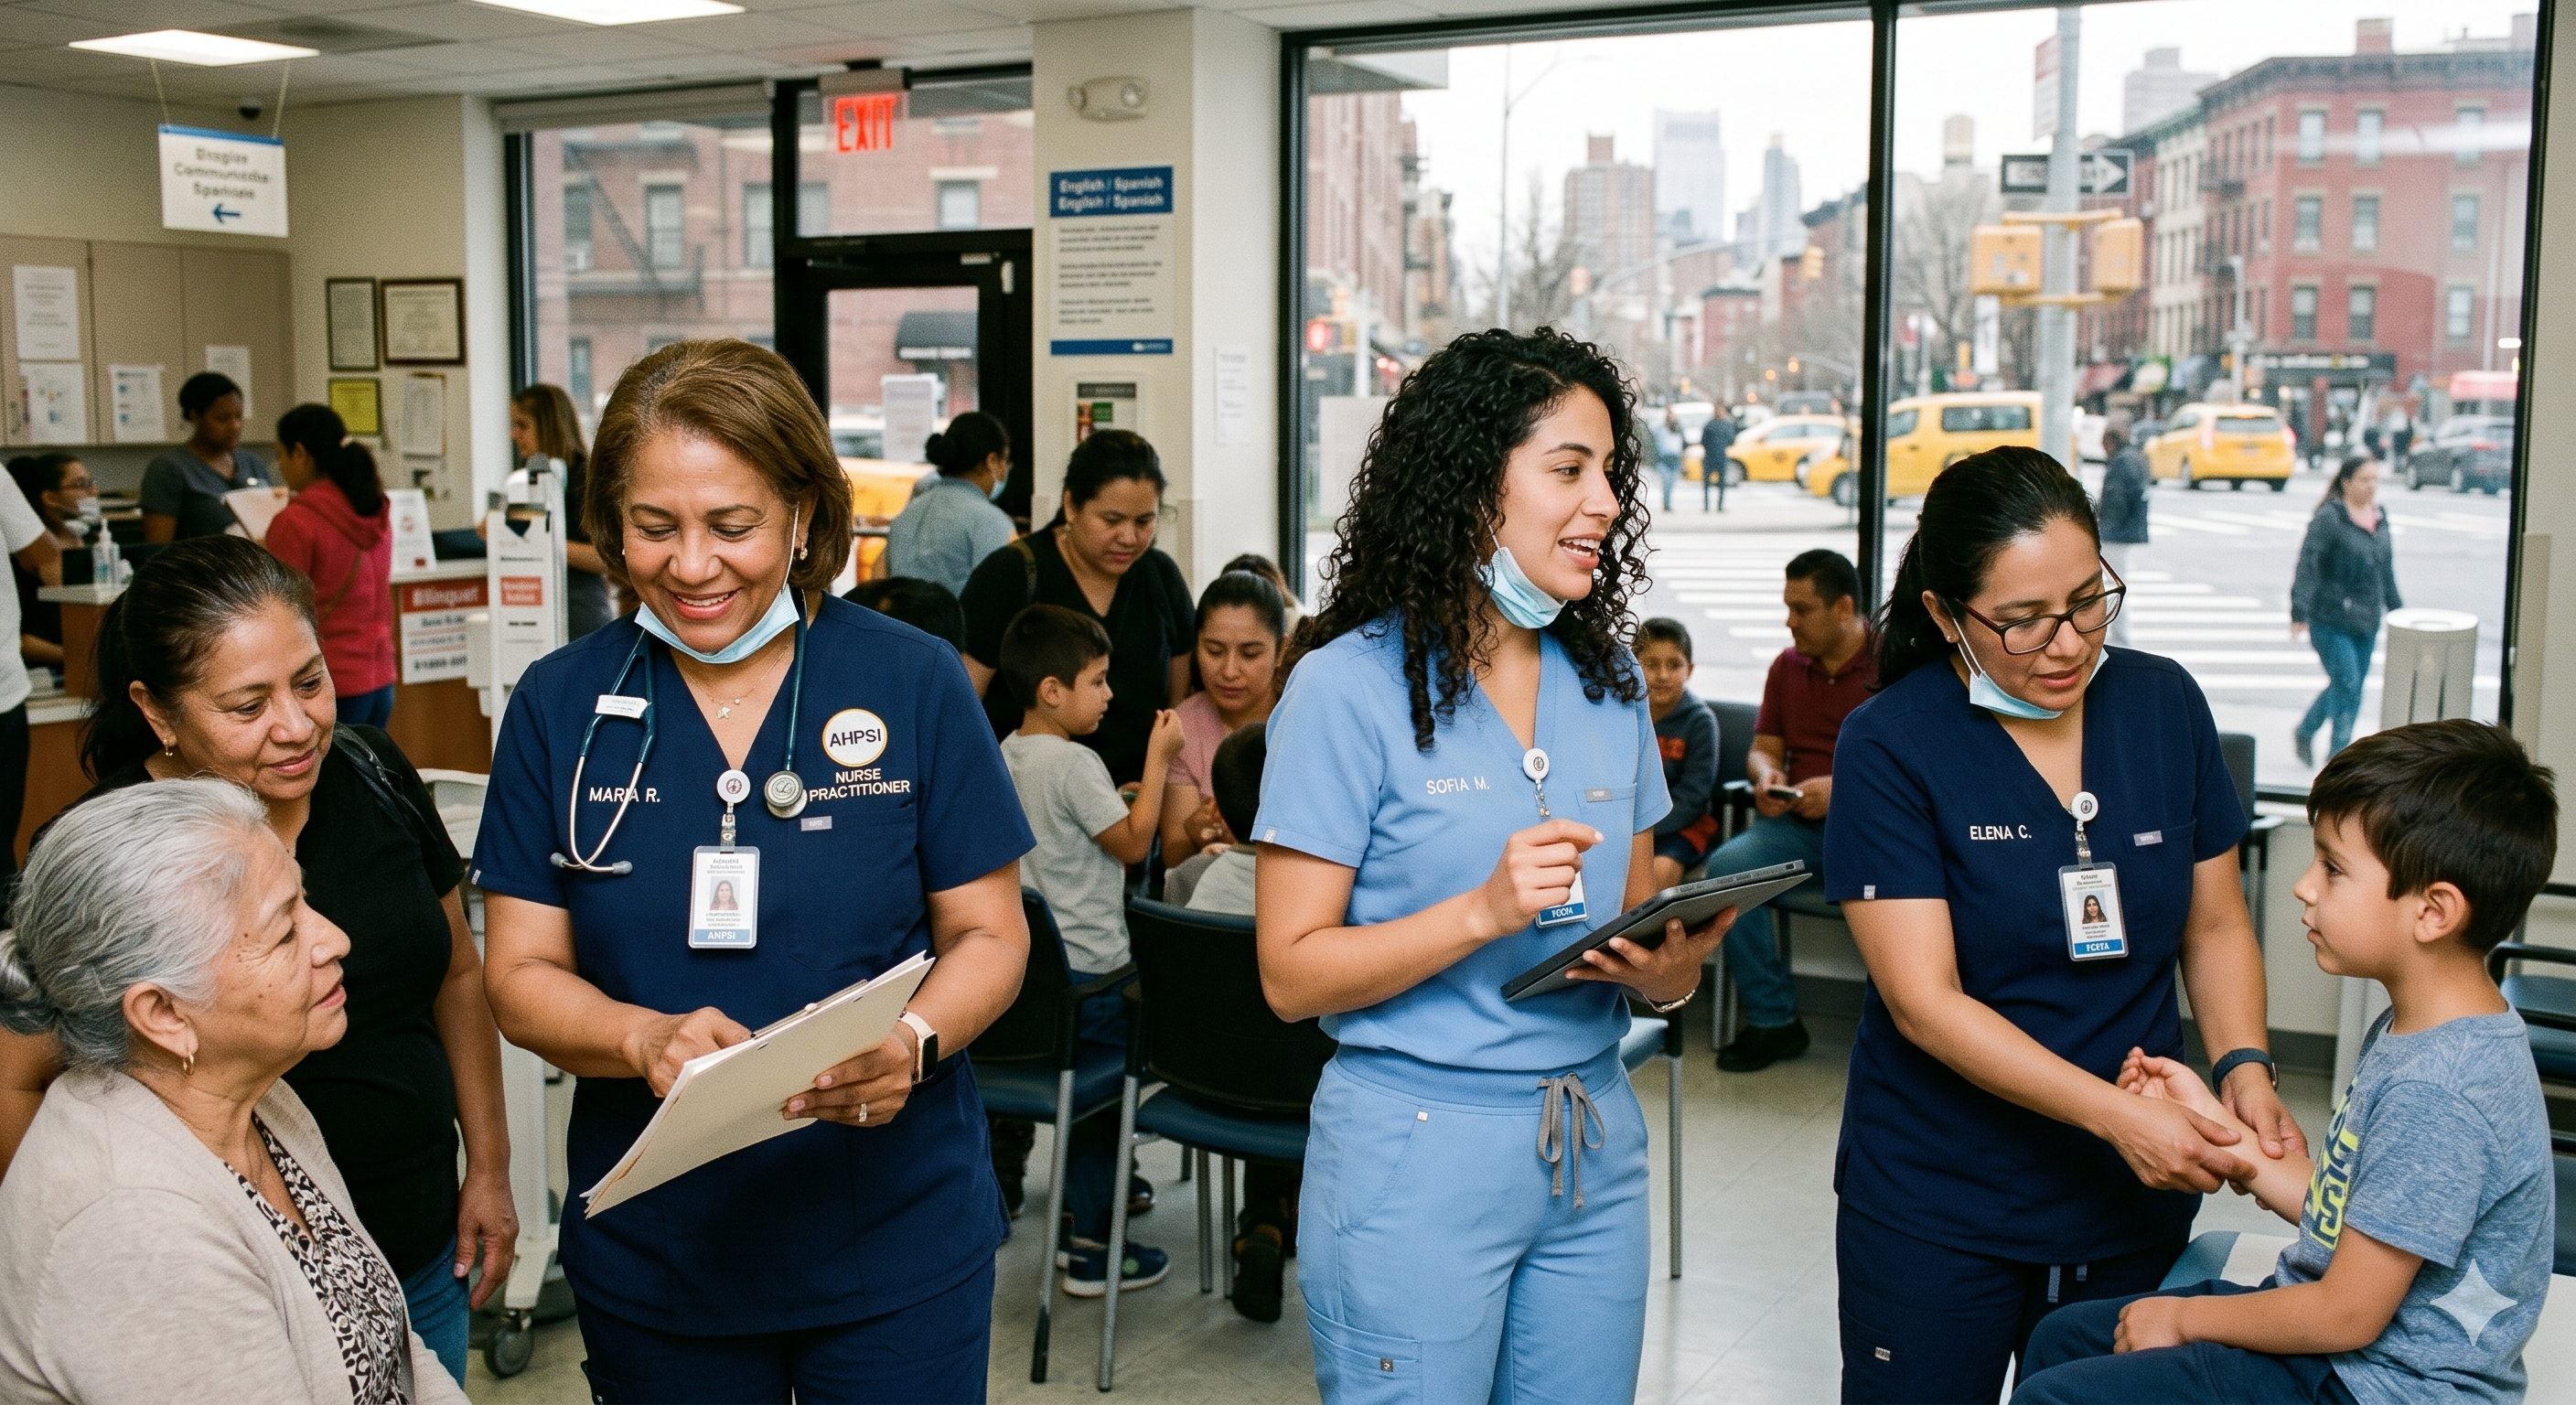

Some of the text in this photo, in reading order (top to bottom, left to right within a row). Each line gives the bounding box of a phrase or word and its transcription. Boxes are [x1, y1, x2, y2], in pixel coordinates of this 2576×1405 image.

[835, 93, 897, 153] EXIT
[1059, 177, 1104, 195] English
[1114, 176, 1164, 193] Spanish
[1058, 195, 1104, 213] English
[1113, 192, 1165, 209] Spanish
[830, 728, 882, 747] AHPSI
[835, 768, 882, 784] NURSE
[1426, 776, 1490, 795] SOFIA M.
[646, 788, 660, 803] R.
[809, 780, 910, 802] PRACTITIONER
[1970, 824, 2033, 841] ELENA C.
